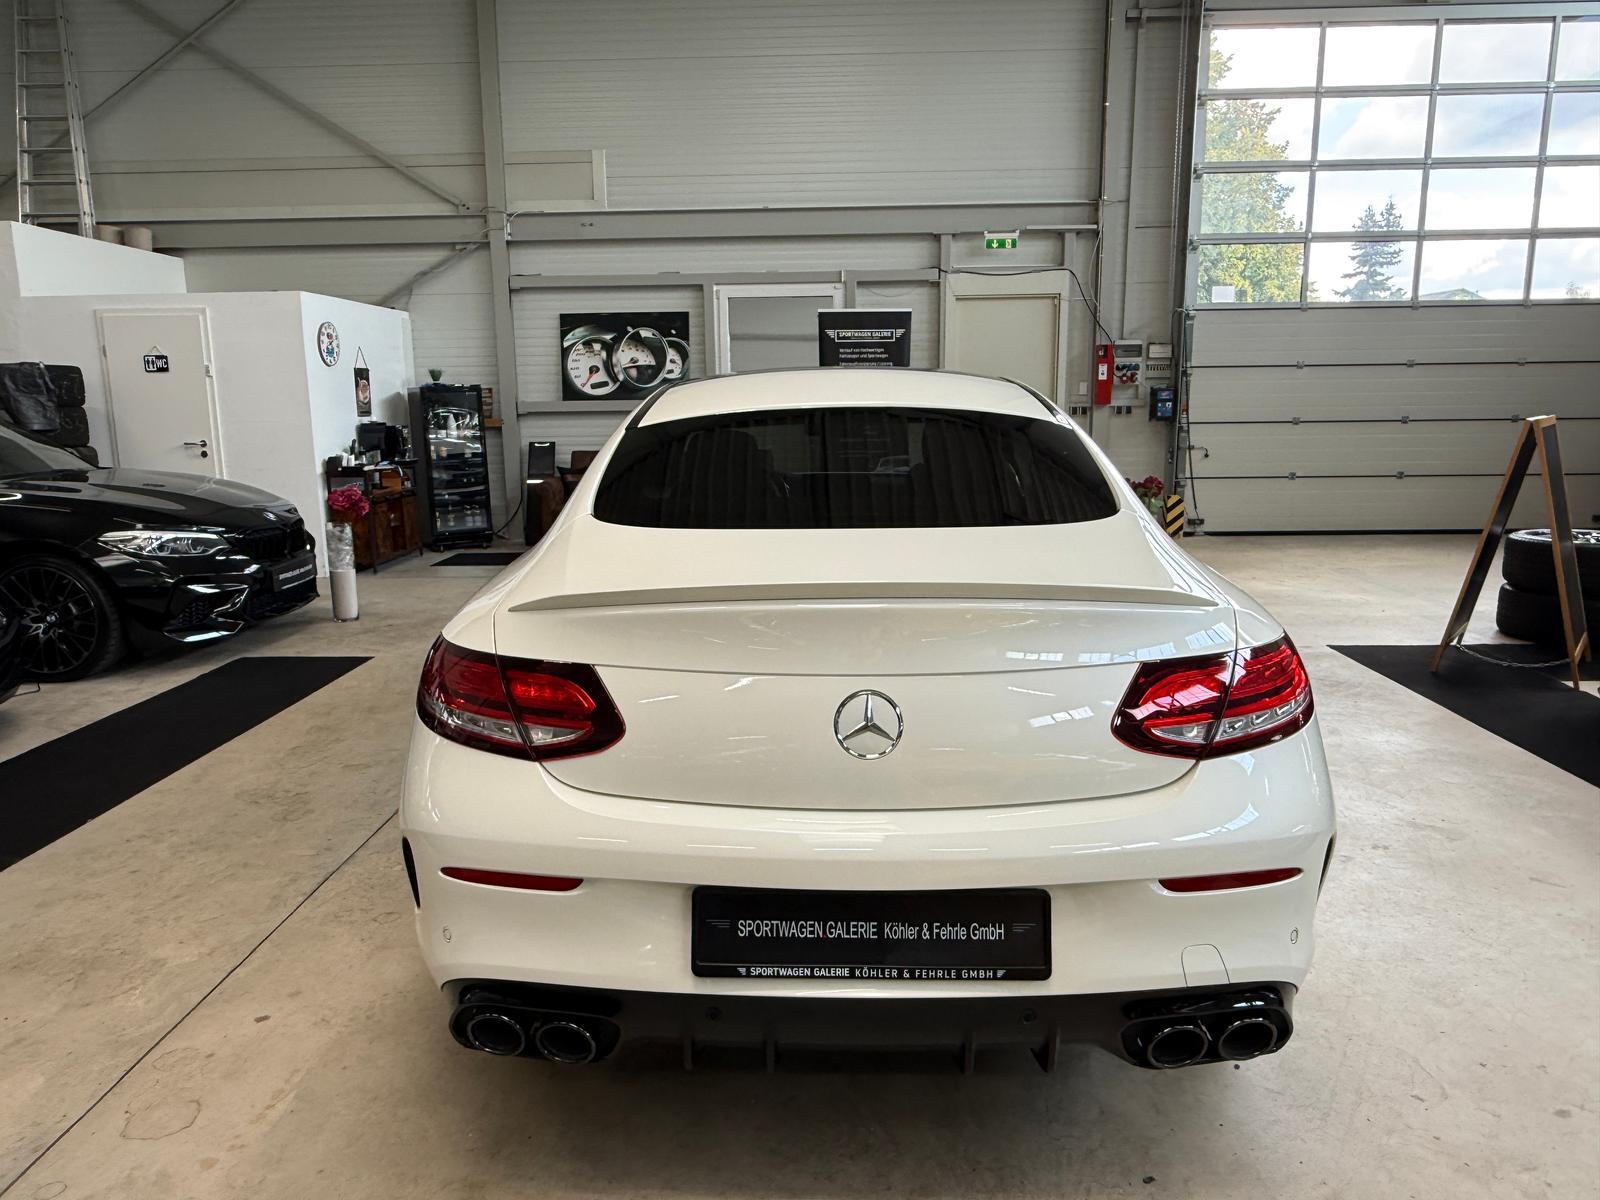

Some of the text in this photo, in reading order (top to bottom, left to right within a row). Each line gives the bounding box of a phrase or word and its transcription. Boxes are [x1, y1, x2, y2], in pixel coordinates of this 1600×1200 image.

[156, 359, 168, 368] WC
[883, 922, 919, 940] Köhler
[921, 922, 930, 940] &
[933, 922, 967, 940] Fehrle
[969, 922, 1005, 941] GmbH
[750, 966, 994, 979] SPORTWAGEN GALERIE KÖHLER & FEHRLE GMBH
